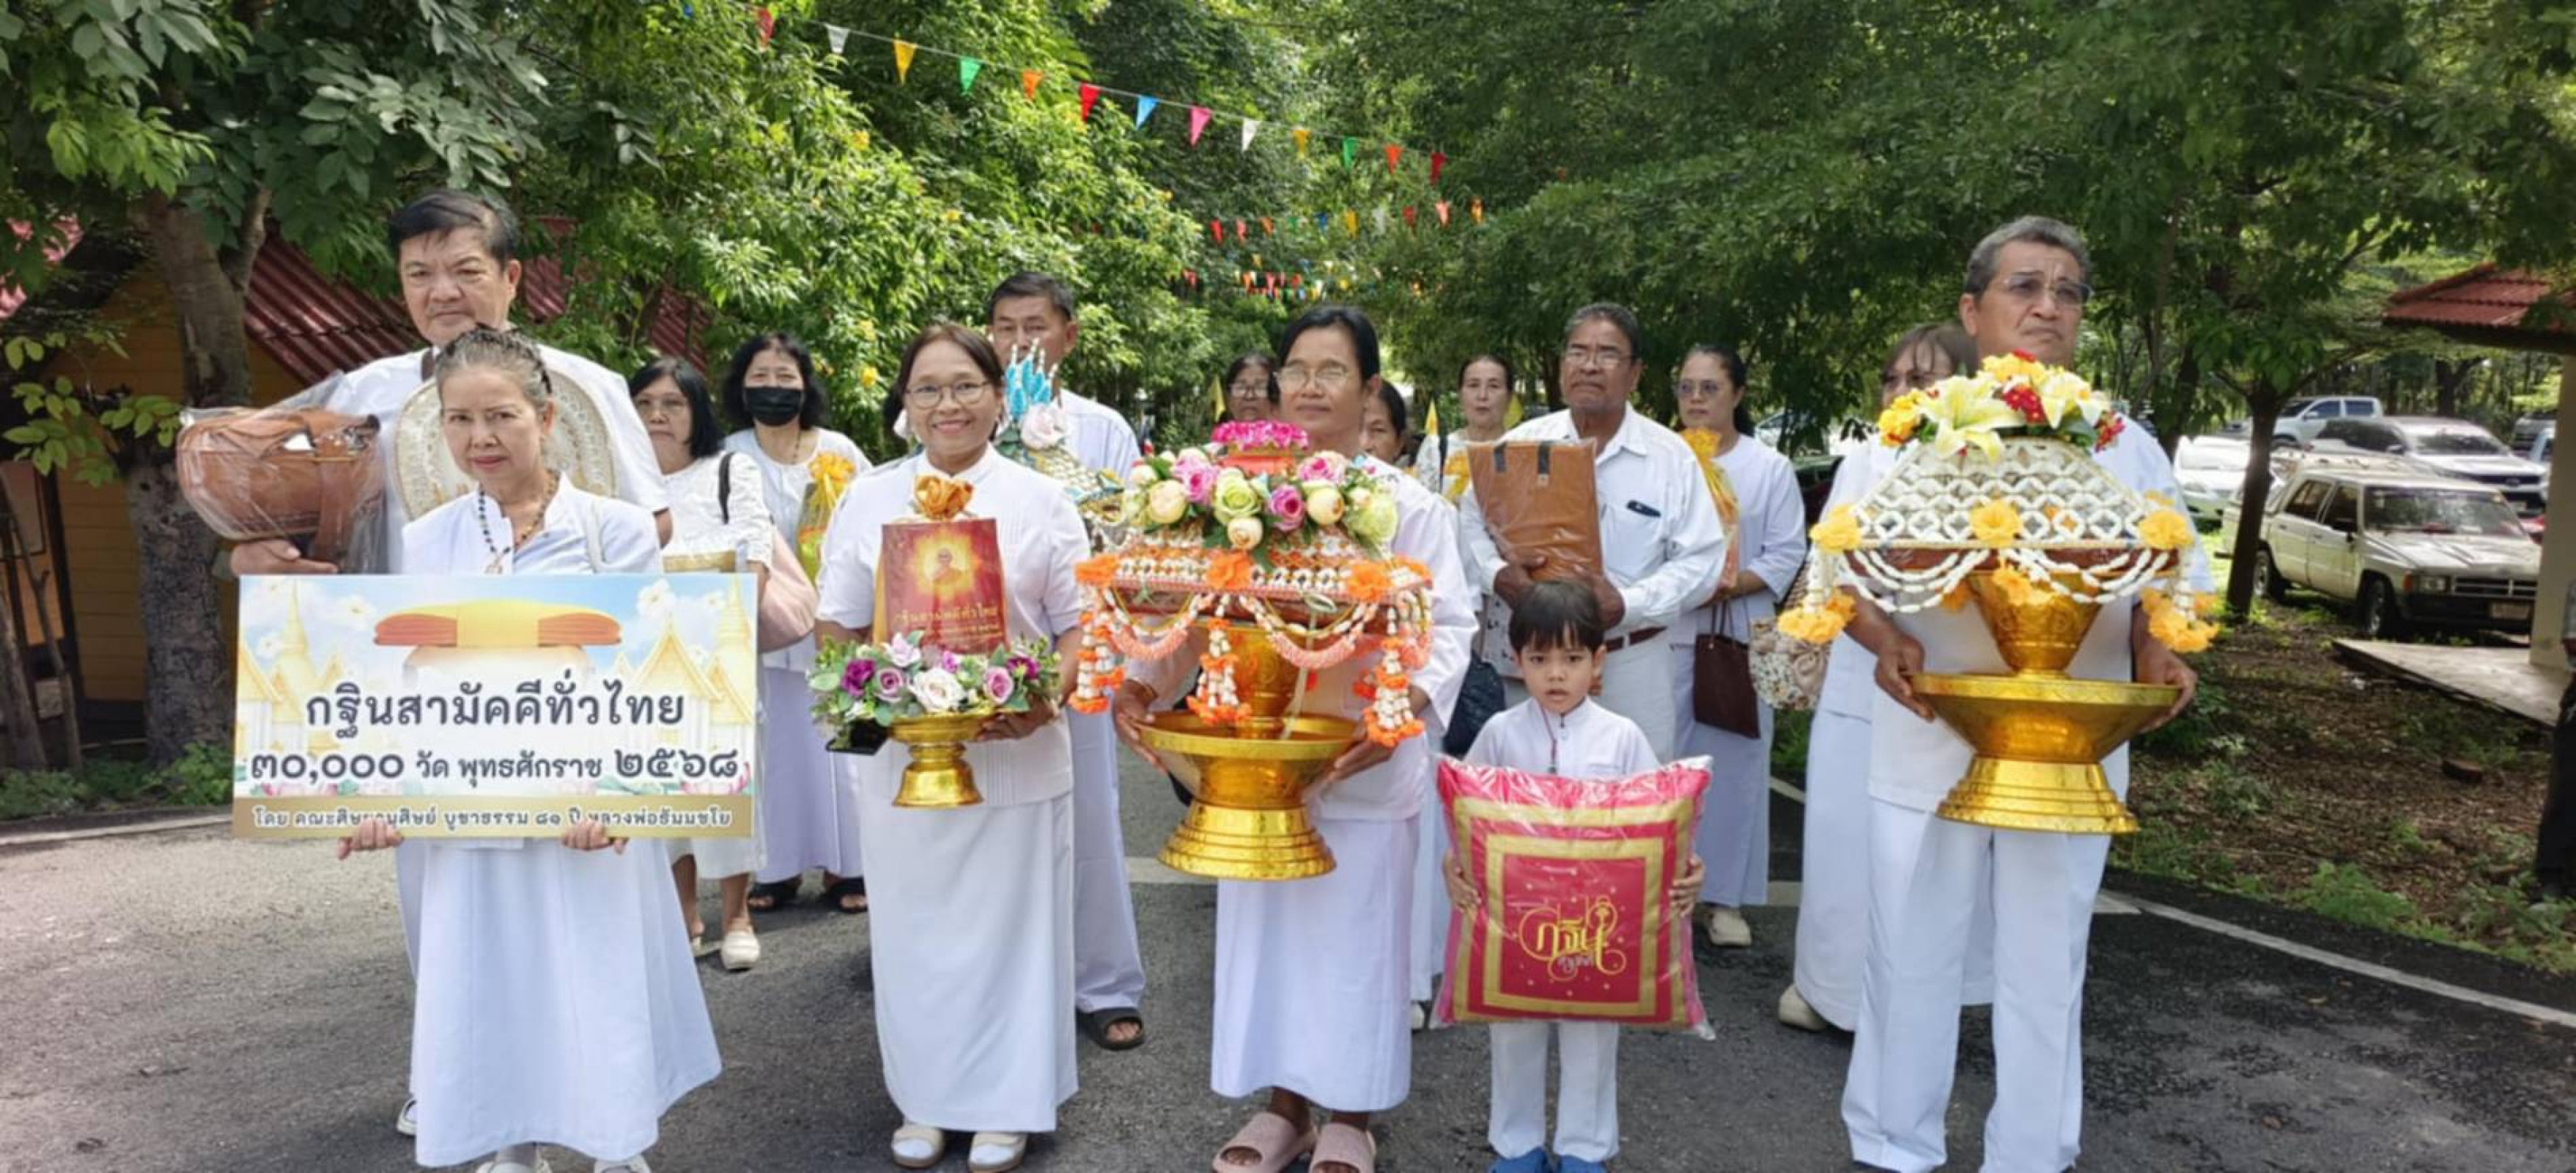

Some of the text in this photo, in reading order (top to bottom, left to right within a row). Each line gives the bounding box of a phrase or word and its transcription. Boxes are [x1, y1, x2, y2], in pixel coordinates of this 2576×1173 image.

[306, 669, 684, 738] กฐินสามัคคีทั่วไทย
[252, 749, 738, 787] ๓๐,๐๐๐ วัด พุทธศักราช ๒๕๖๘
[255, 807, 287, 825] โดย
[445, 812, 528, 831] บูชาธรรม
[536, 813, 561, 825] ๘๑
[569, 806, 580, 825] ปี
